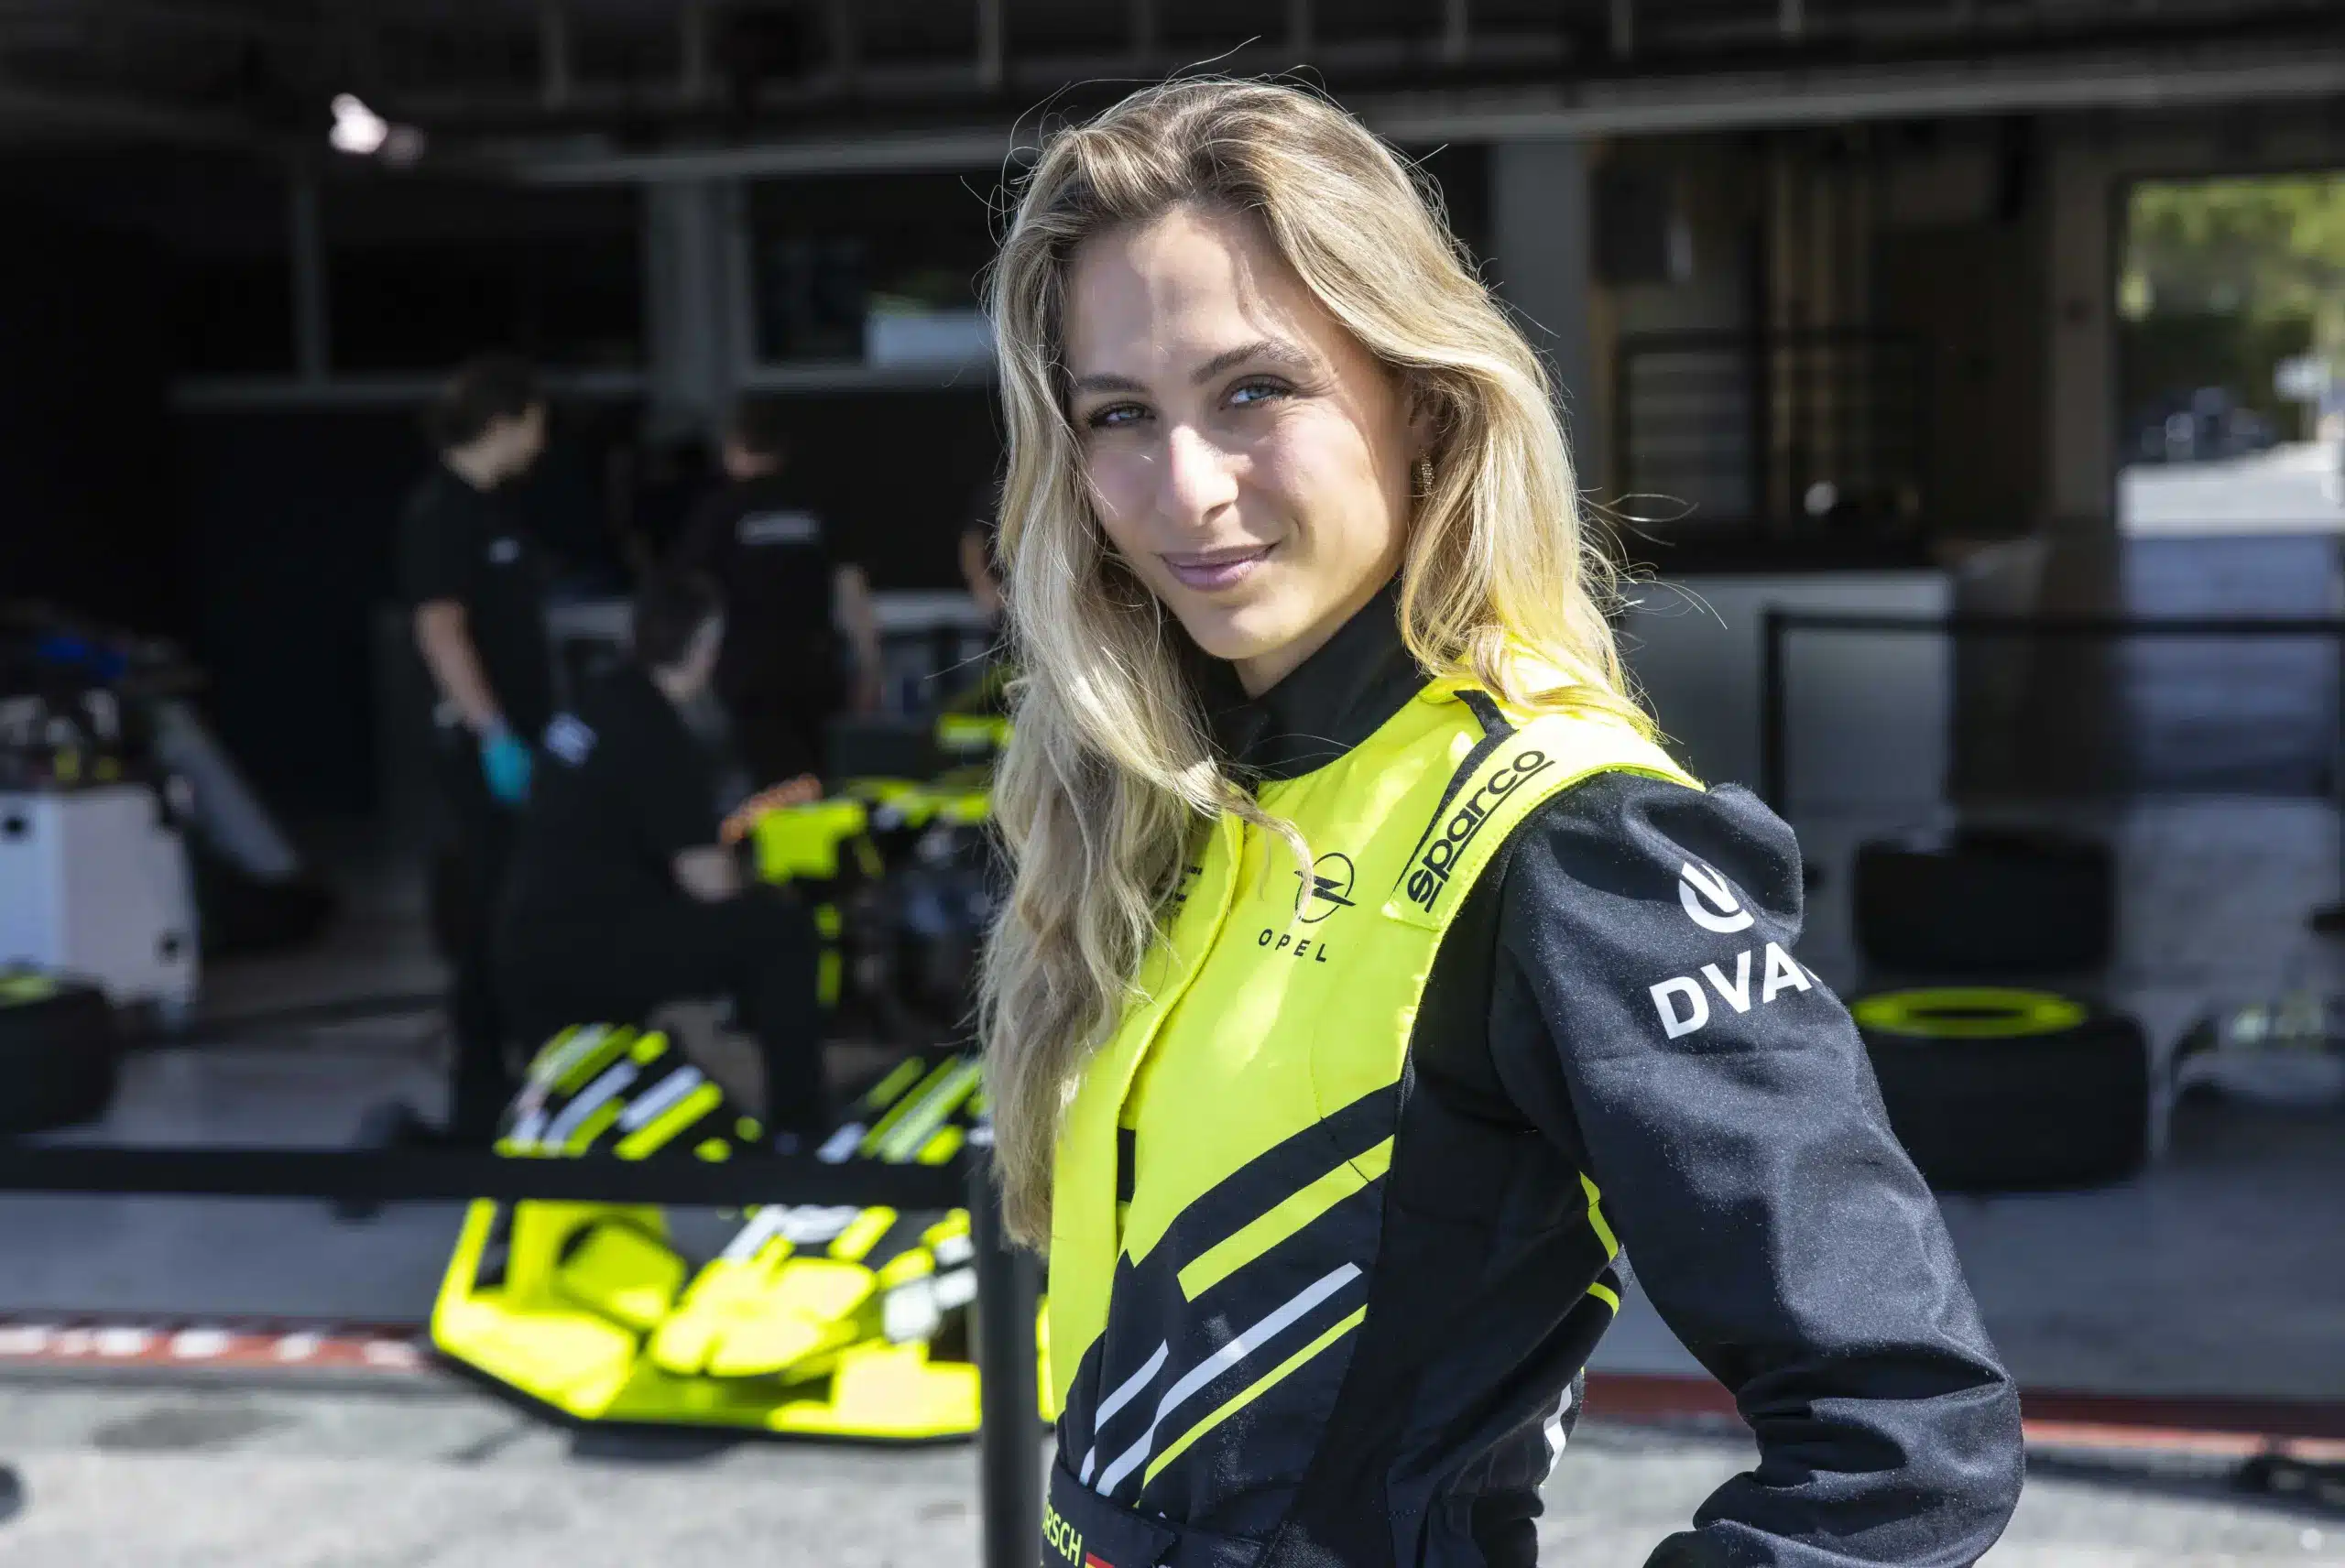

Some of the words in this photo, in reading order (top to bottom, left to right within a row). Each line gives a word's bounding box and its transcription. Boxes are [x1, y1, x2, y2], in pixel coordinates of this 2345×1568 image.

[1407, 750, 1553, 912] sparco
[1258, 929, 1327, 963] OPEL
[1649, 942, 1822, 1040] DVA
